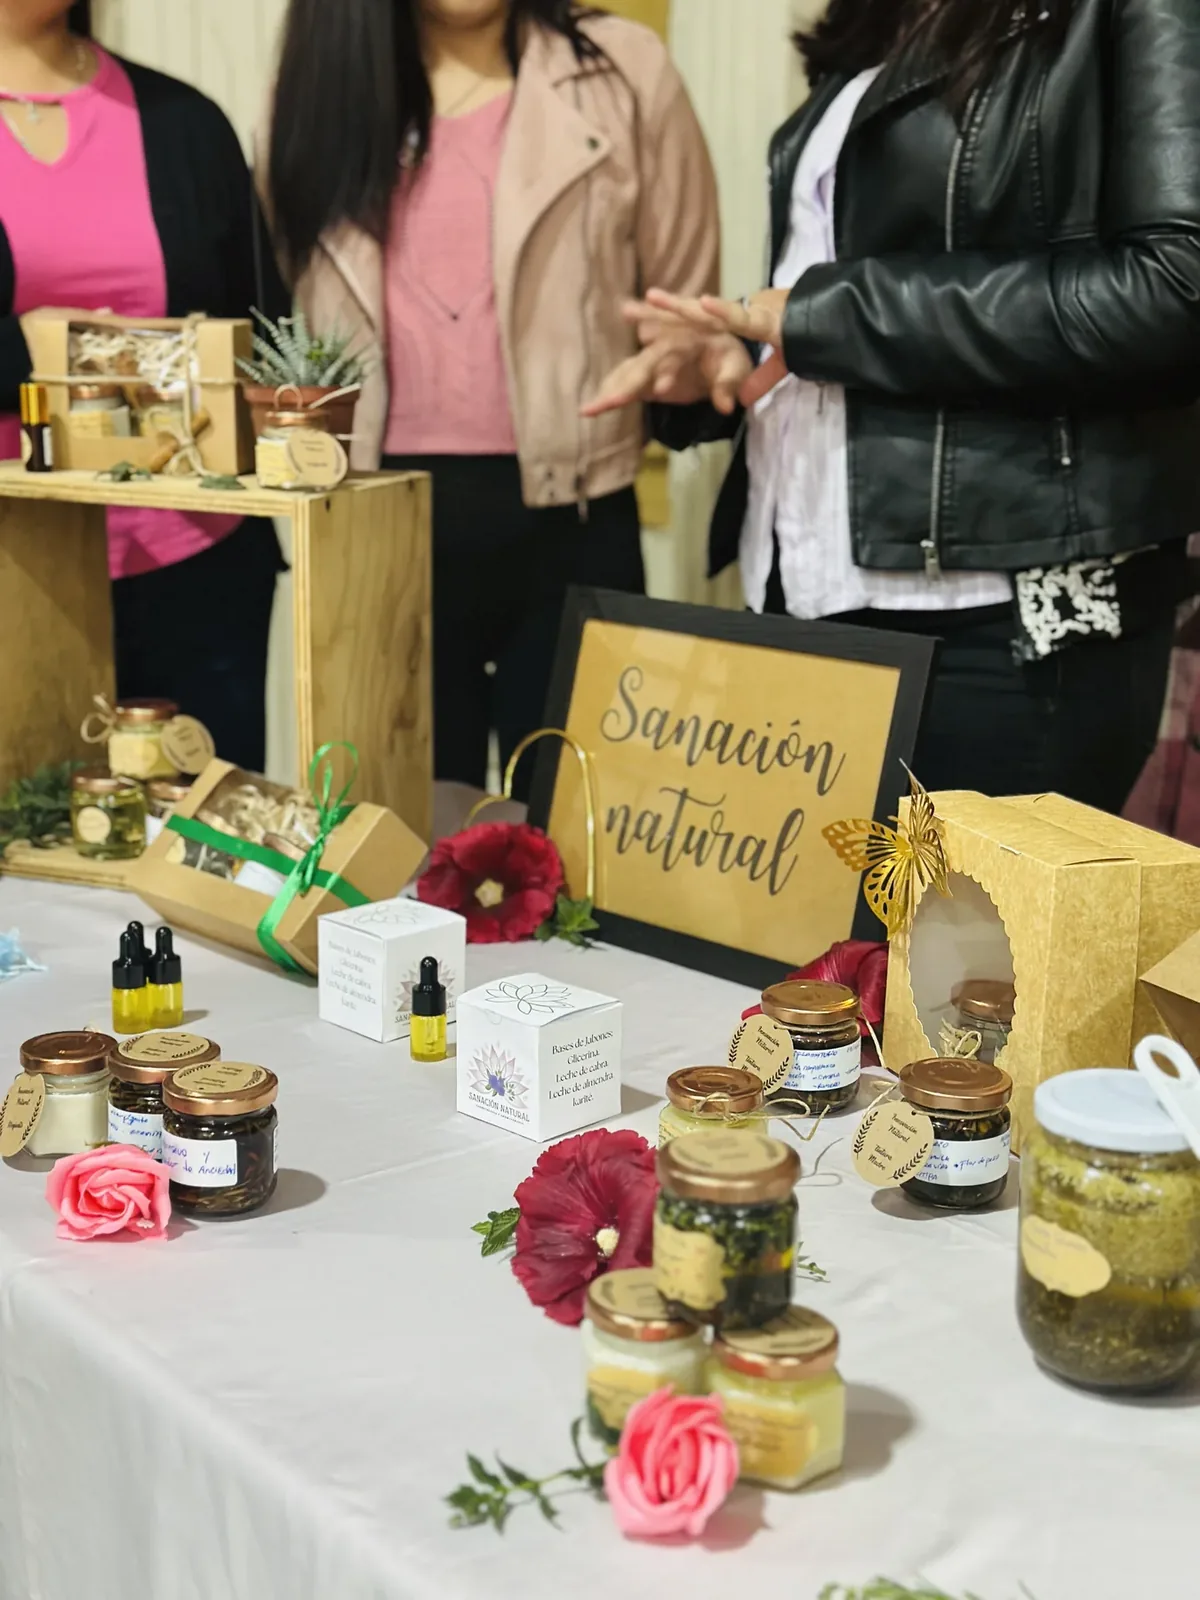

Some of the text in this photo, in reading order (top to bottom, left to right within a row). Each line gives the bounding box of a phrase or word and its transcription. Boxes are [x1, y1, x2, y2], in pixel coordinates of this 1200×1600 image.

[599, 666, 846, 796] Sanación
[606, 787, 804, 896] natural
[552, 1042, 574, 1055] Bases
[574, 1038, 584, 1049] de
[555, 1060, 609, 1083] Leche de cabra
[548, 1072, 614, 1100] Leche de almendra
[468, 1091, 499, 1110] SANACIÓN
[500, 1104, 530, 1122] NATURAL
[888, 1126, 911, 1143] Natural
[868, 1154, 886, 1171] Madre
